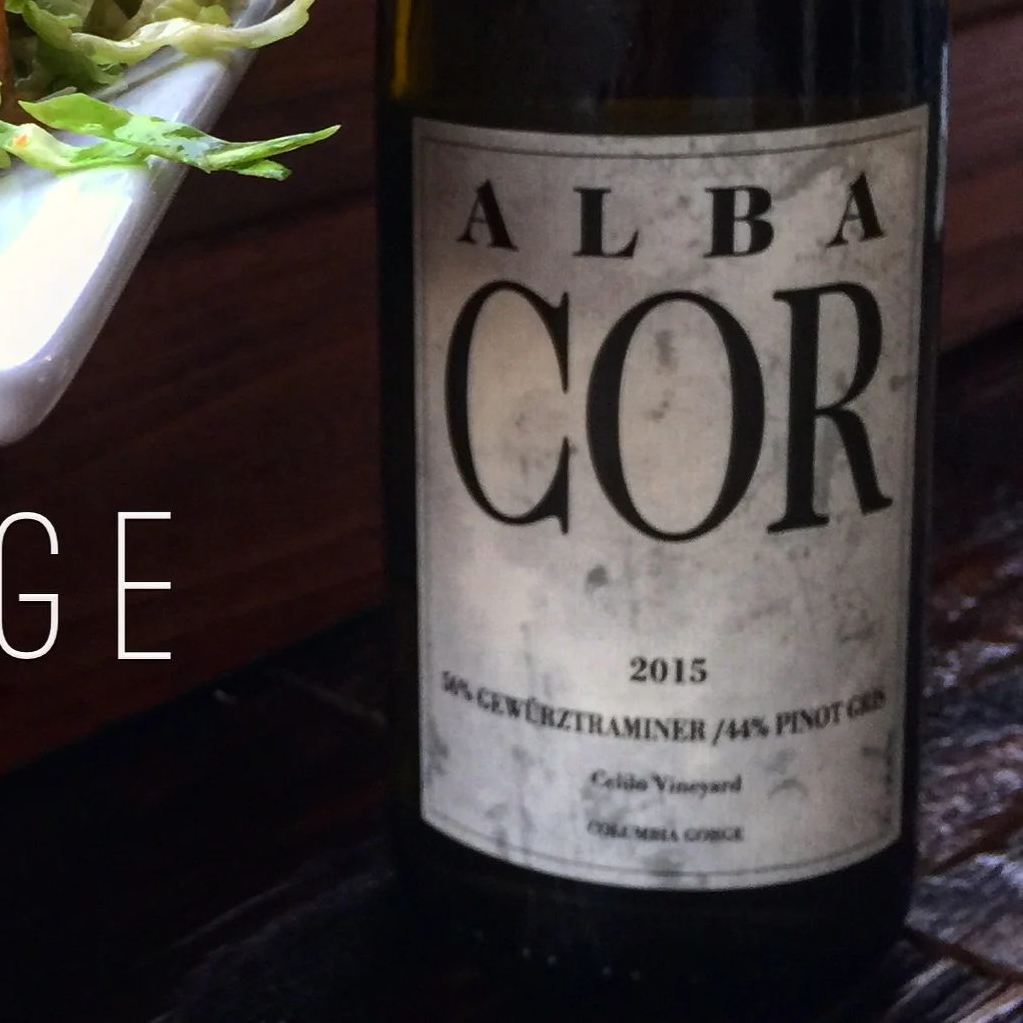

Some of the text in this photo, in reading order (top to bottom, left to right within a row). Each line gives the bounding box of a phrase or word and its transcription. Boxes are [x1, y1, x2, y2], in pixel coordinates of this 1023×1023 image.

[456, 170, 886, 260] ALBA
[443, 279, 894, 543] COR
[628, 655, 709, 684] 2015
[476, 686, 707, 743] GEWÜRZTRAMINER
[775, 700, 842, 736] PINOT
[651, 771, 743, 801] Vineyard
